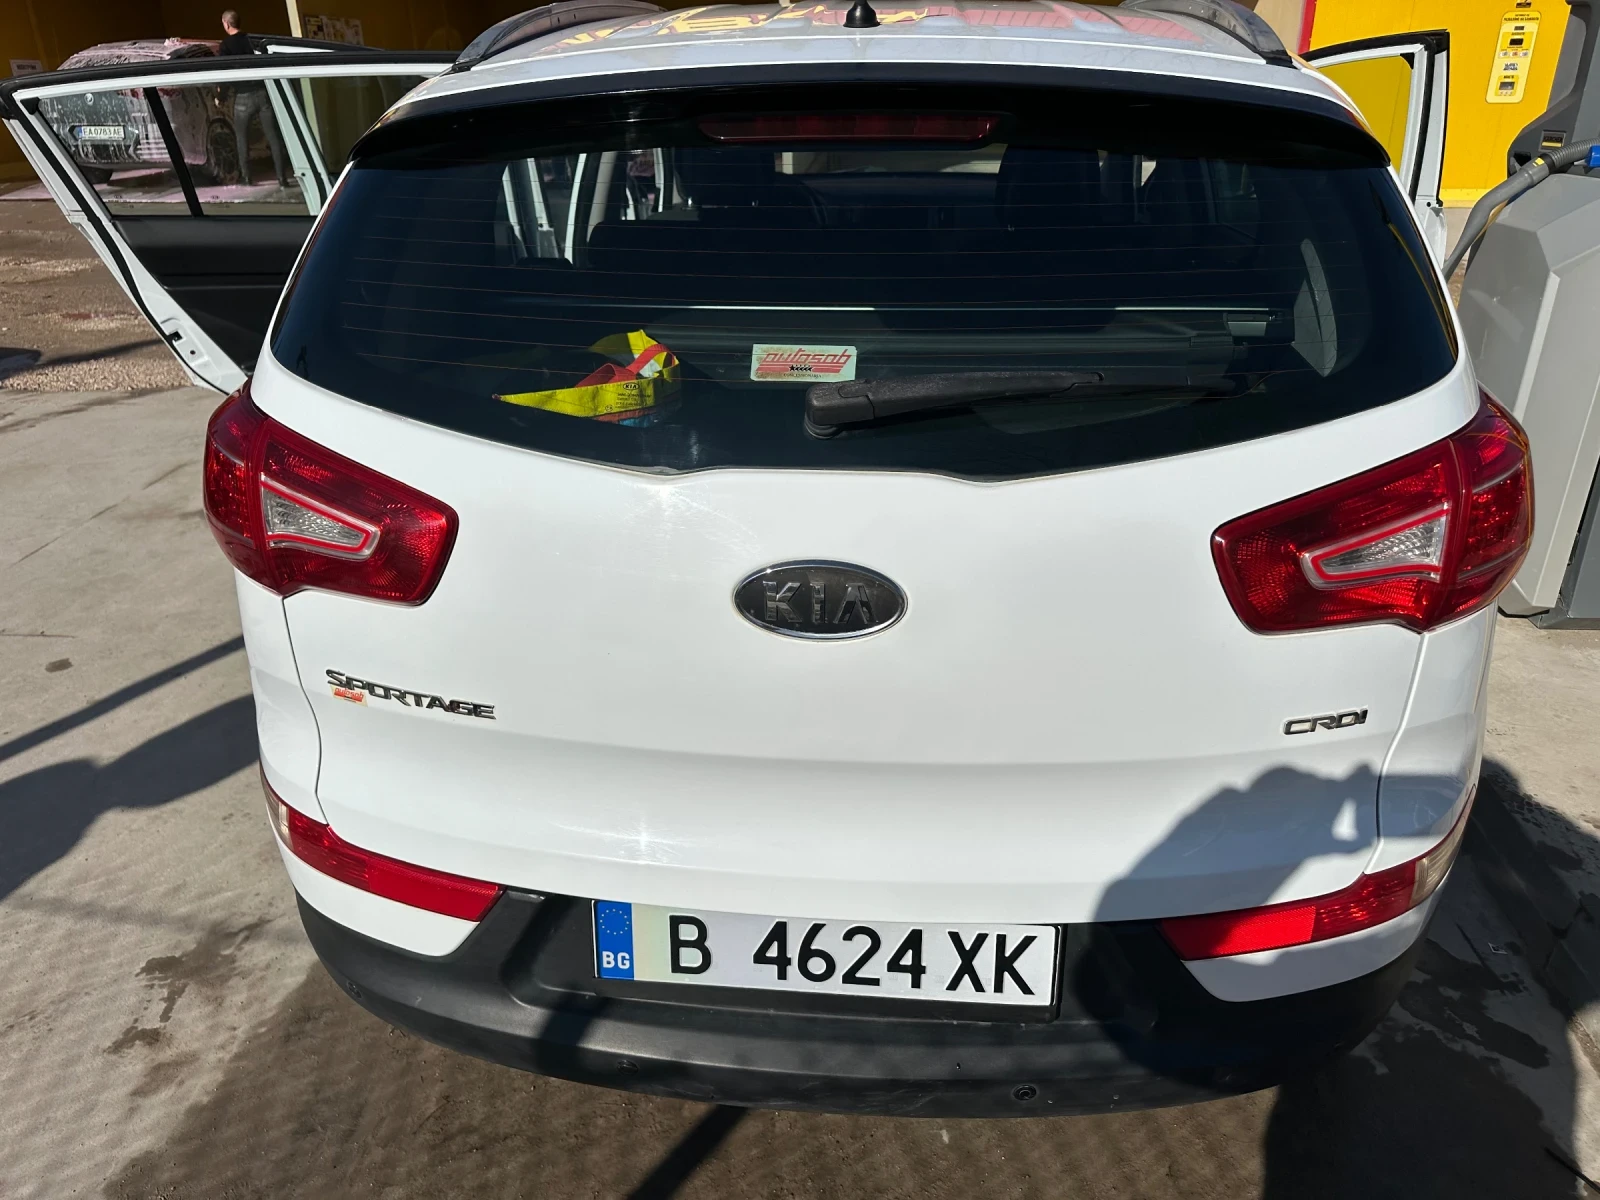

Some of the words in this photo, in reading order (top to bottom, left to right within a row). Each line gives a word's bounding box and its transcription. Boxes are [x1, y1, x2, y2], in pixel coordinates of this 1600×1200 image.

[763, 581, 877, 624] KIA
[326, 669, 497, 720] SPORTAGE
[602, 951, 631, 970] BG
[669, 915, 713, 975] B
[752, 920, 927, 989] 4624
[945, 930, 1037, 996] XK
